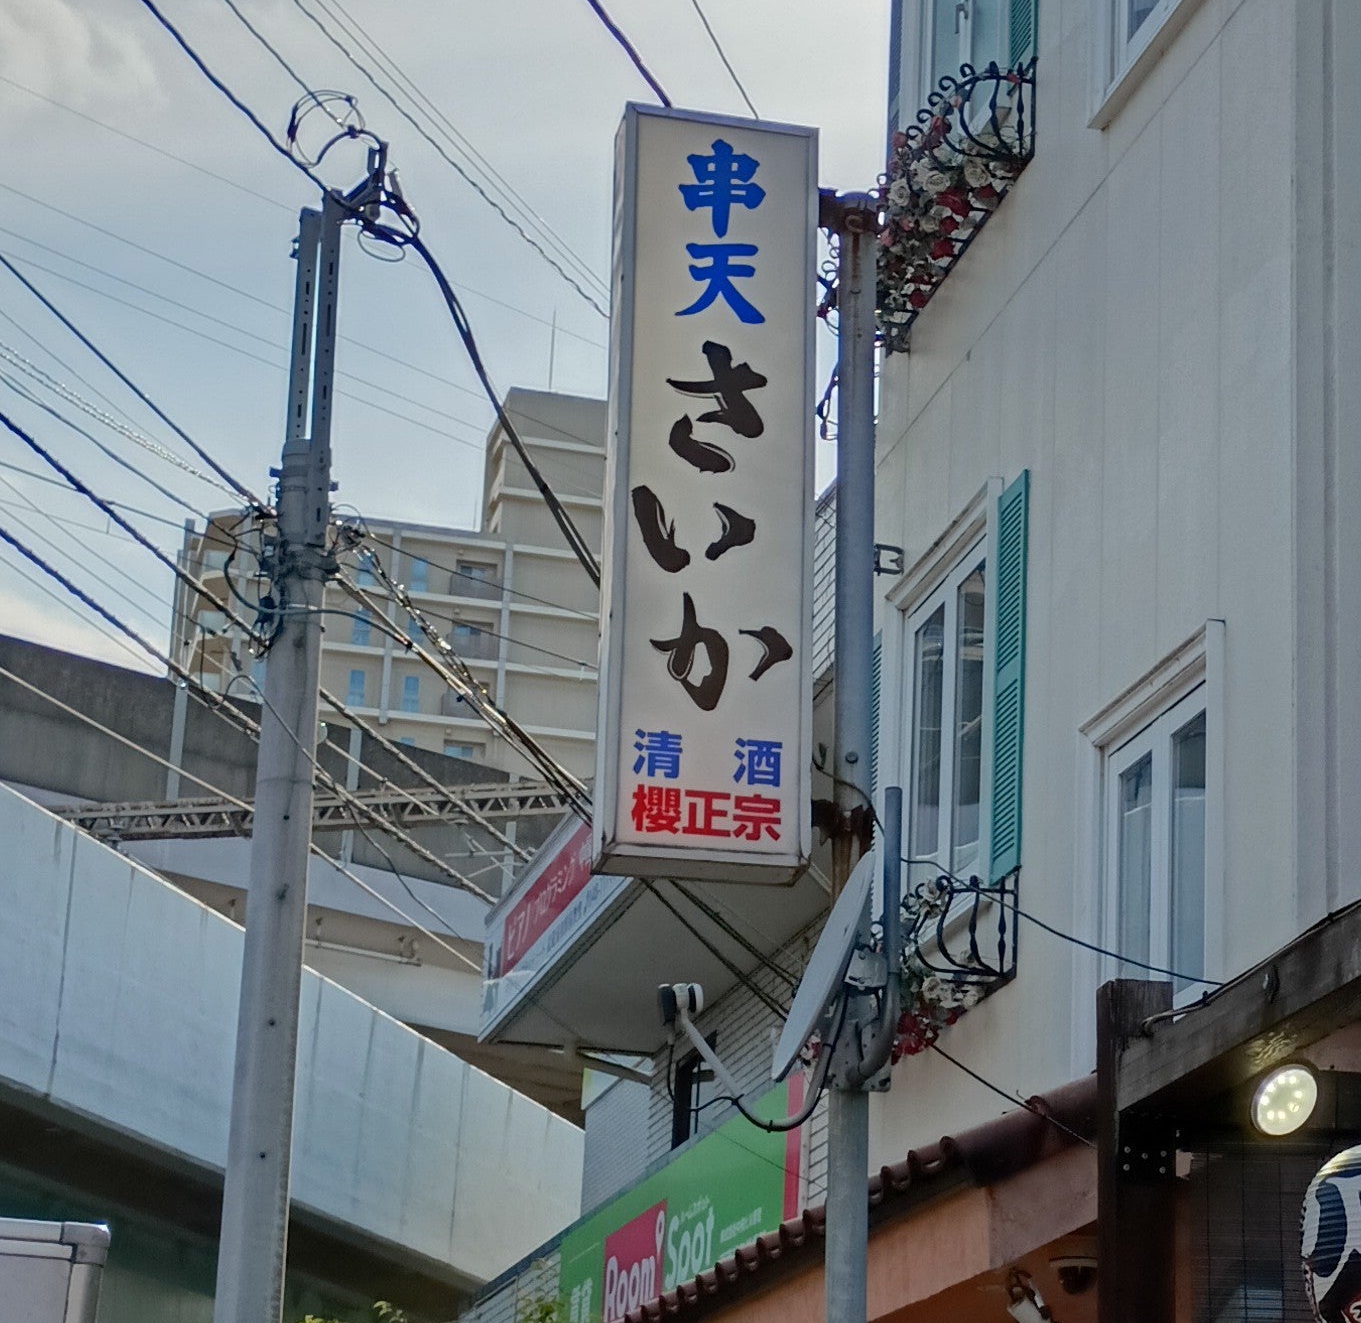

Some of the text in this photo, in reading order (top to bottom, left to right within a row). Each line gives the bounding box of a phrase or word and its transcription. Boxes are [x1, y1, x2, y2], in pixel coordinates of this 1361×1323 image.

[632, 139, 793, 712] 串天 さいか
[631, 784, 781, 842] 櫻正宗
[604, 1255, 656, 1323] Room
[666, 1206, 715, 1289] Spot
